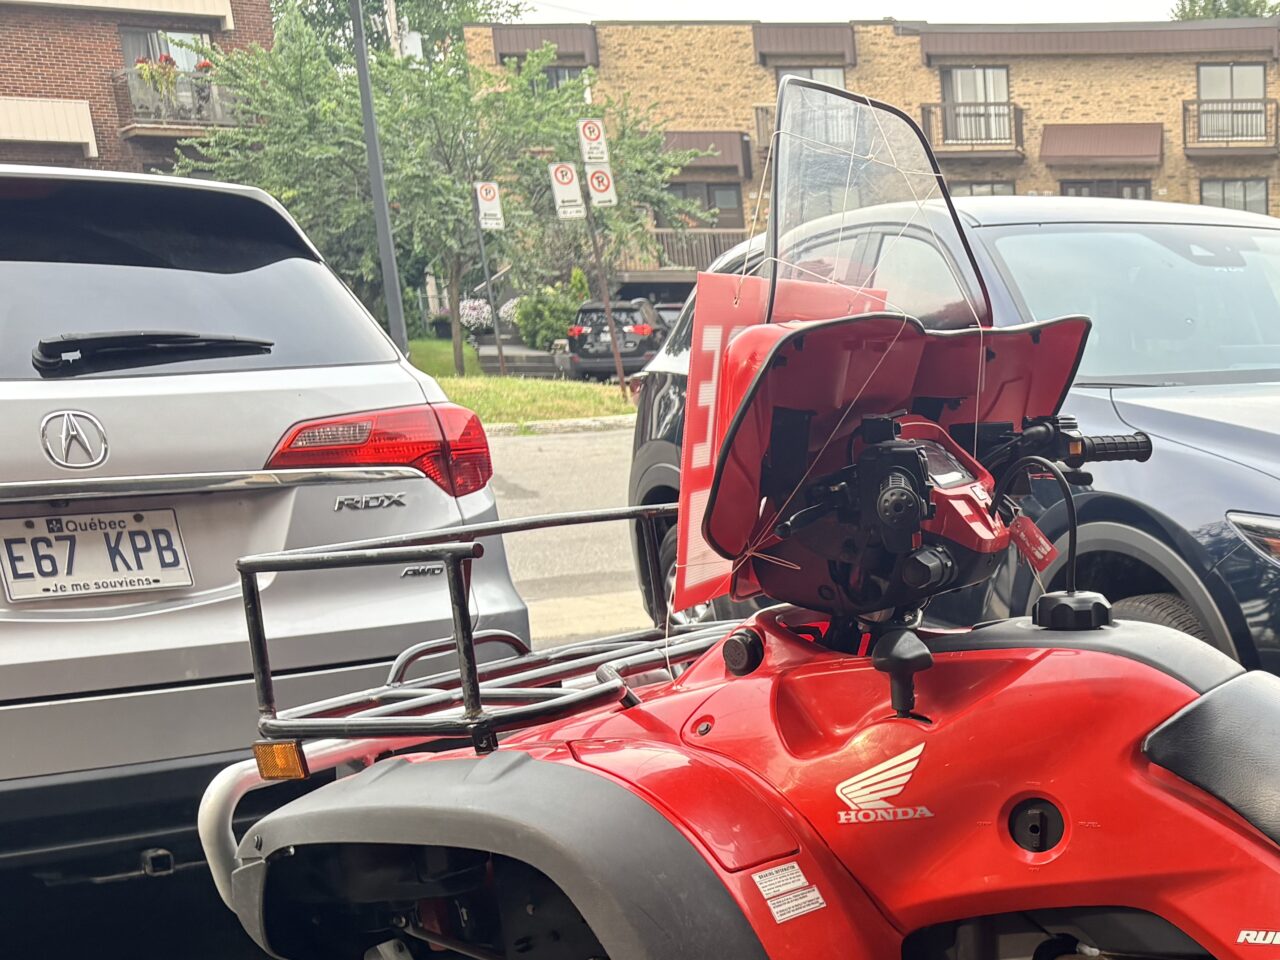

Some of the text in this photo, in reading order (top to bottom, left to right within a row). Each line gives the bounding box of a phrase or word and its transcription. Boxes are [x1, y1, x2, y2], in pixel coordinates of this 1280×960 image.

[333, 491, 407, 512] RDX
[65, 517, 127, 532] Québec
[4, 528, 181, 580] E67 KPB
[401, 564, 444, 578] AWD
[51, 576, 152, 593] Je me souviens
[837, 805, 935, 824] HONDA
